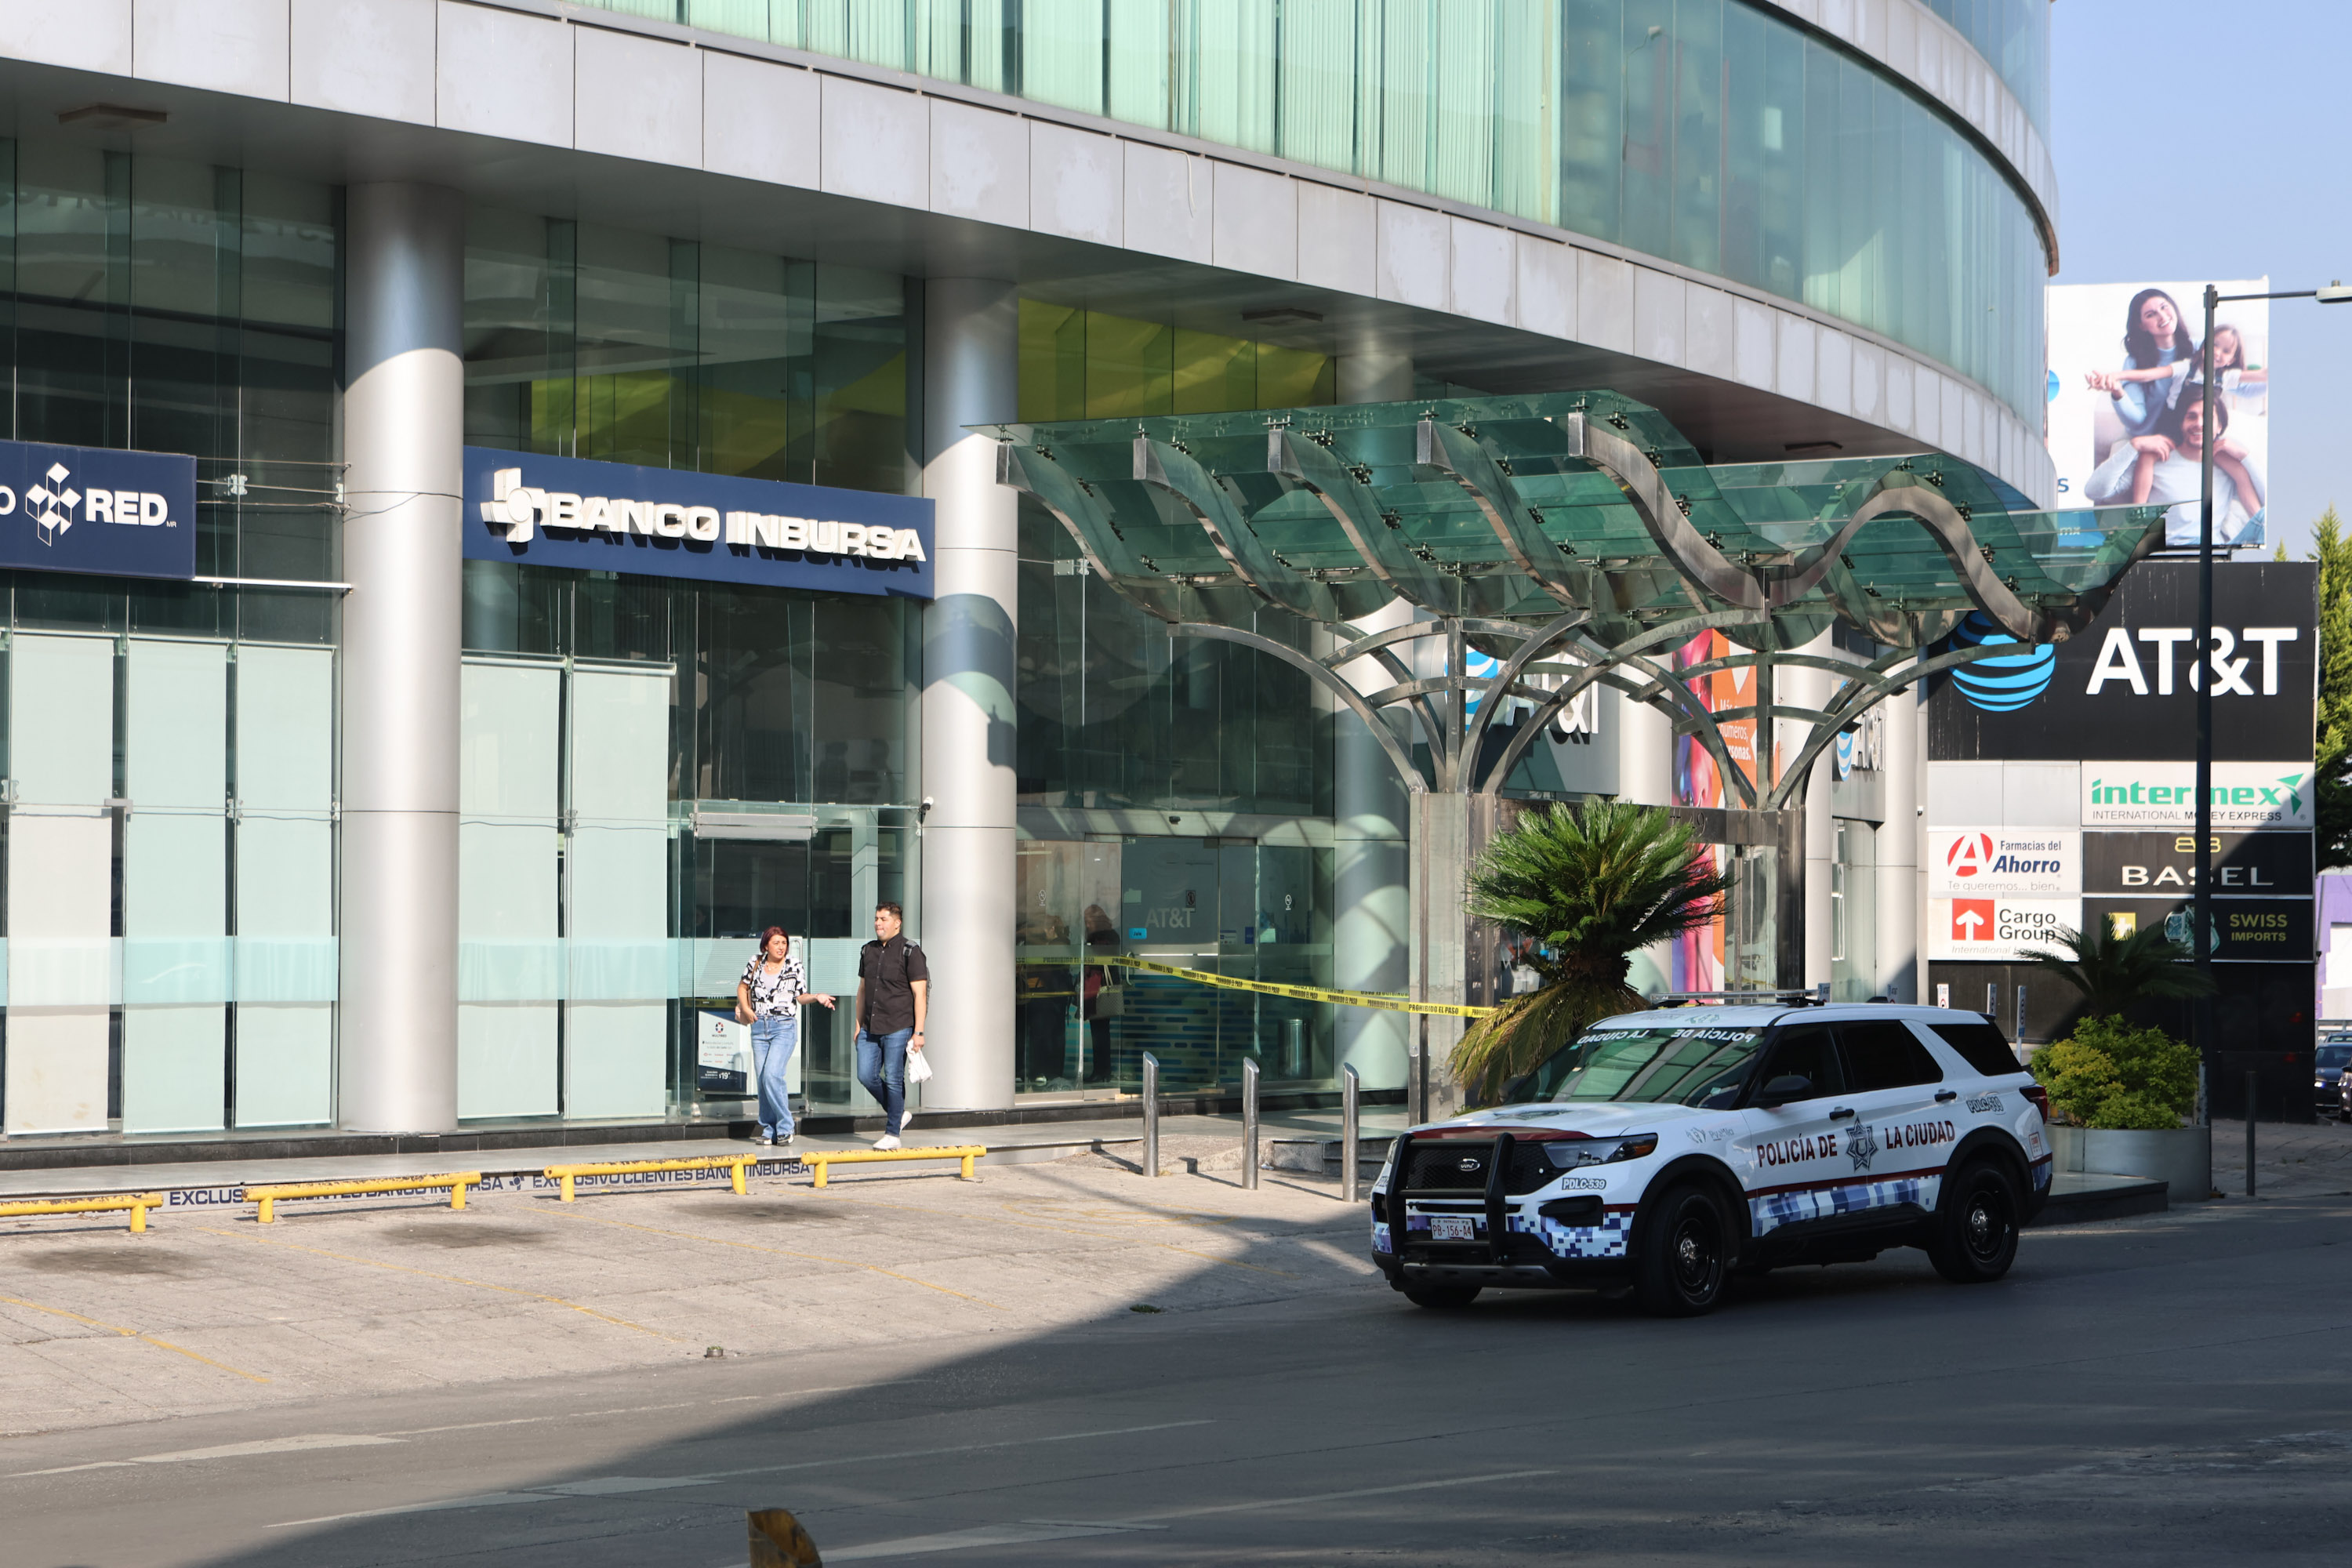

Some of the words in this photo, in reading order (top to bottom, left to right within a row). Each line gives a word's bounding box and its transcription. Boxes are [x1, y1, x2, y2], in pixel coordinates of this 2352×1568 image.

[85, 488, 168, 526] RED
[543, 492, 720, 541] BANCO
[726, 511, 927, 562] INBURSA
[2085, 627, 2298, 697] AT&T
[1727, 745, 1751, 760] rsonas.
[2092, 811, 2181, 821] INTERNATIONAL
[2185, 811, 2225, 821] MEY
[2229, 811, 2282, 822] EXPRESS
[2000, 840, 2045, 851] Farmacias
[2048, 840, 2062, 851] del
[1992, 855, 2060, 873] Ahorro
[1948, 881, 1960, 891] Te
[1145, 908, 1196, 928] AT&T
[1999, 909, 2056, 927] Cargo
[2230, 914, 2288, 927] SWISS
[1999, 925, 2056, 943] Group
[2231, 932, 2286, 942] IMPORTS
[1952, 946, 2011, 956] International
[1409, 1004, 1438, 1013] PROHIBIDO
[1756, 1133, 1815, 1167] POLICÍA
[1818, 1134, 1838, 1158] DE
[1885, 1127, 1903, 1149] LA
[1905, 1120, 1956, 1147] CIUDAD
[533, 1174, 620, 1189] EXUSIVO
[623, 1170, 693, 1183] CLIENTES
[696, 1167, 746, 1181] BAN
[749, 1161, 810, 1177] INBURSA
[1562, 1178, 1606, 1190] PDLC-539
[1432, 1225, 1472, 1236] PB-156-A4
